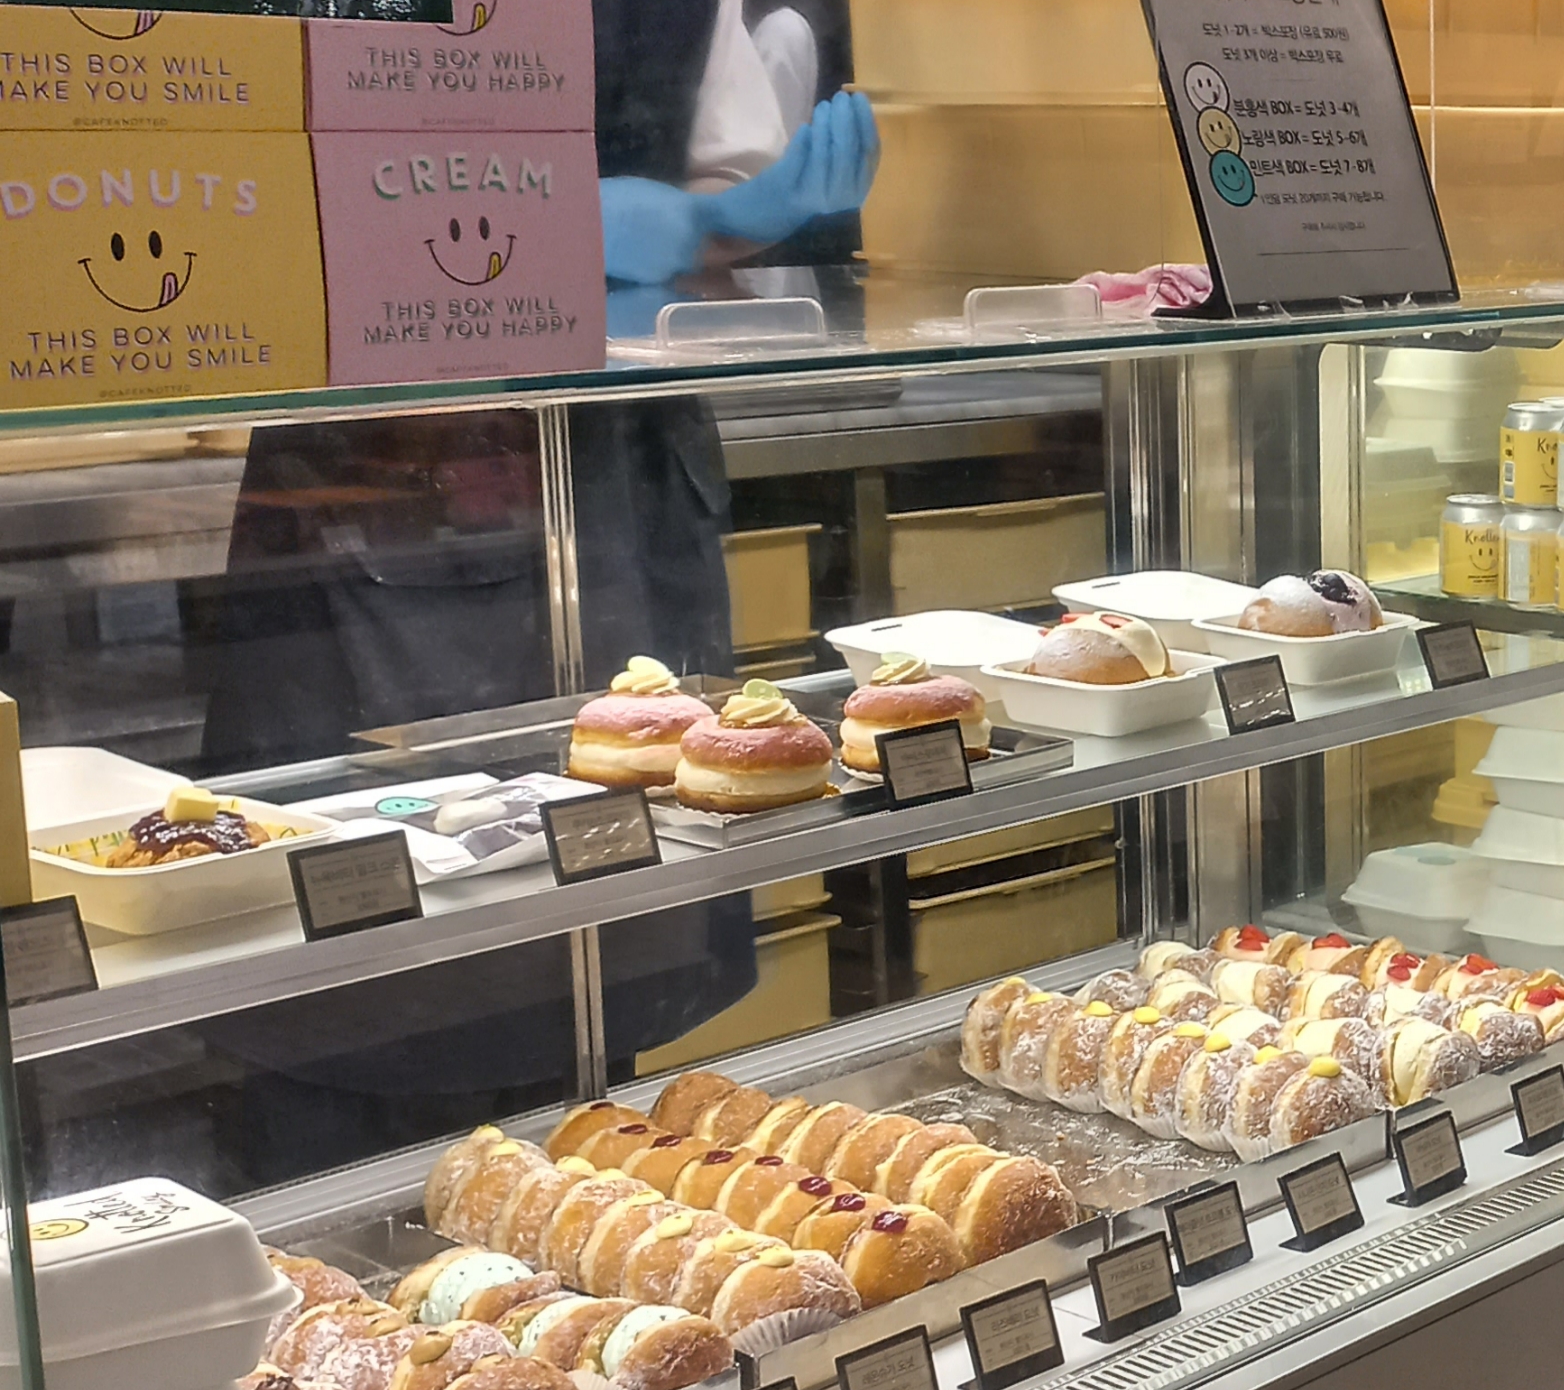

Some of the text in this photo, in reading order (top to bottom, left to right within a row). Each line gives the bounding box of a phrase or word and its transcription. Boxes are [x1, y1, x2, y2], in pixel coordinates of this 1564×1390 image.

[0, 52, 232, 78] THIS BOX WILL
[366, 45, 547, 71] THIS BOX WILL
[0, 80, 250, 105] AKE YOU SMILE
[347, 70, 566, 93] MAKE YOU HAPPY
[1233, 98, 1270, 119] 분홍색
[1304, 100, 1328, 118] 도넛
[1312, 129, 1335, 147] 도넛
[372, 151, 553, 201] CREAM
[1319, 158, 1343, 176] 도넛
[0, 168, 258, 220] DONUTS
[381, 295, 558, 322] THIS BOX WILL
[28, 322, 256, 354] THIS BOX WILL
[364, 315, 578, 345] MAKE YOU HAPPY
[10, 344, 272, 380] MAKE YOU SMILE
